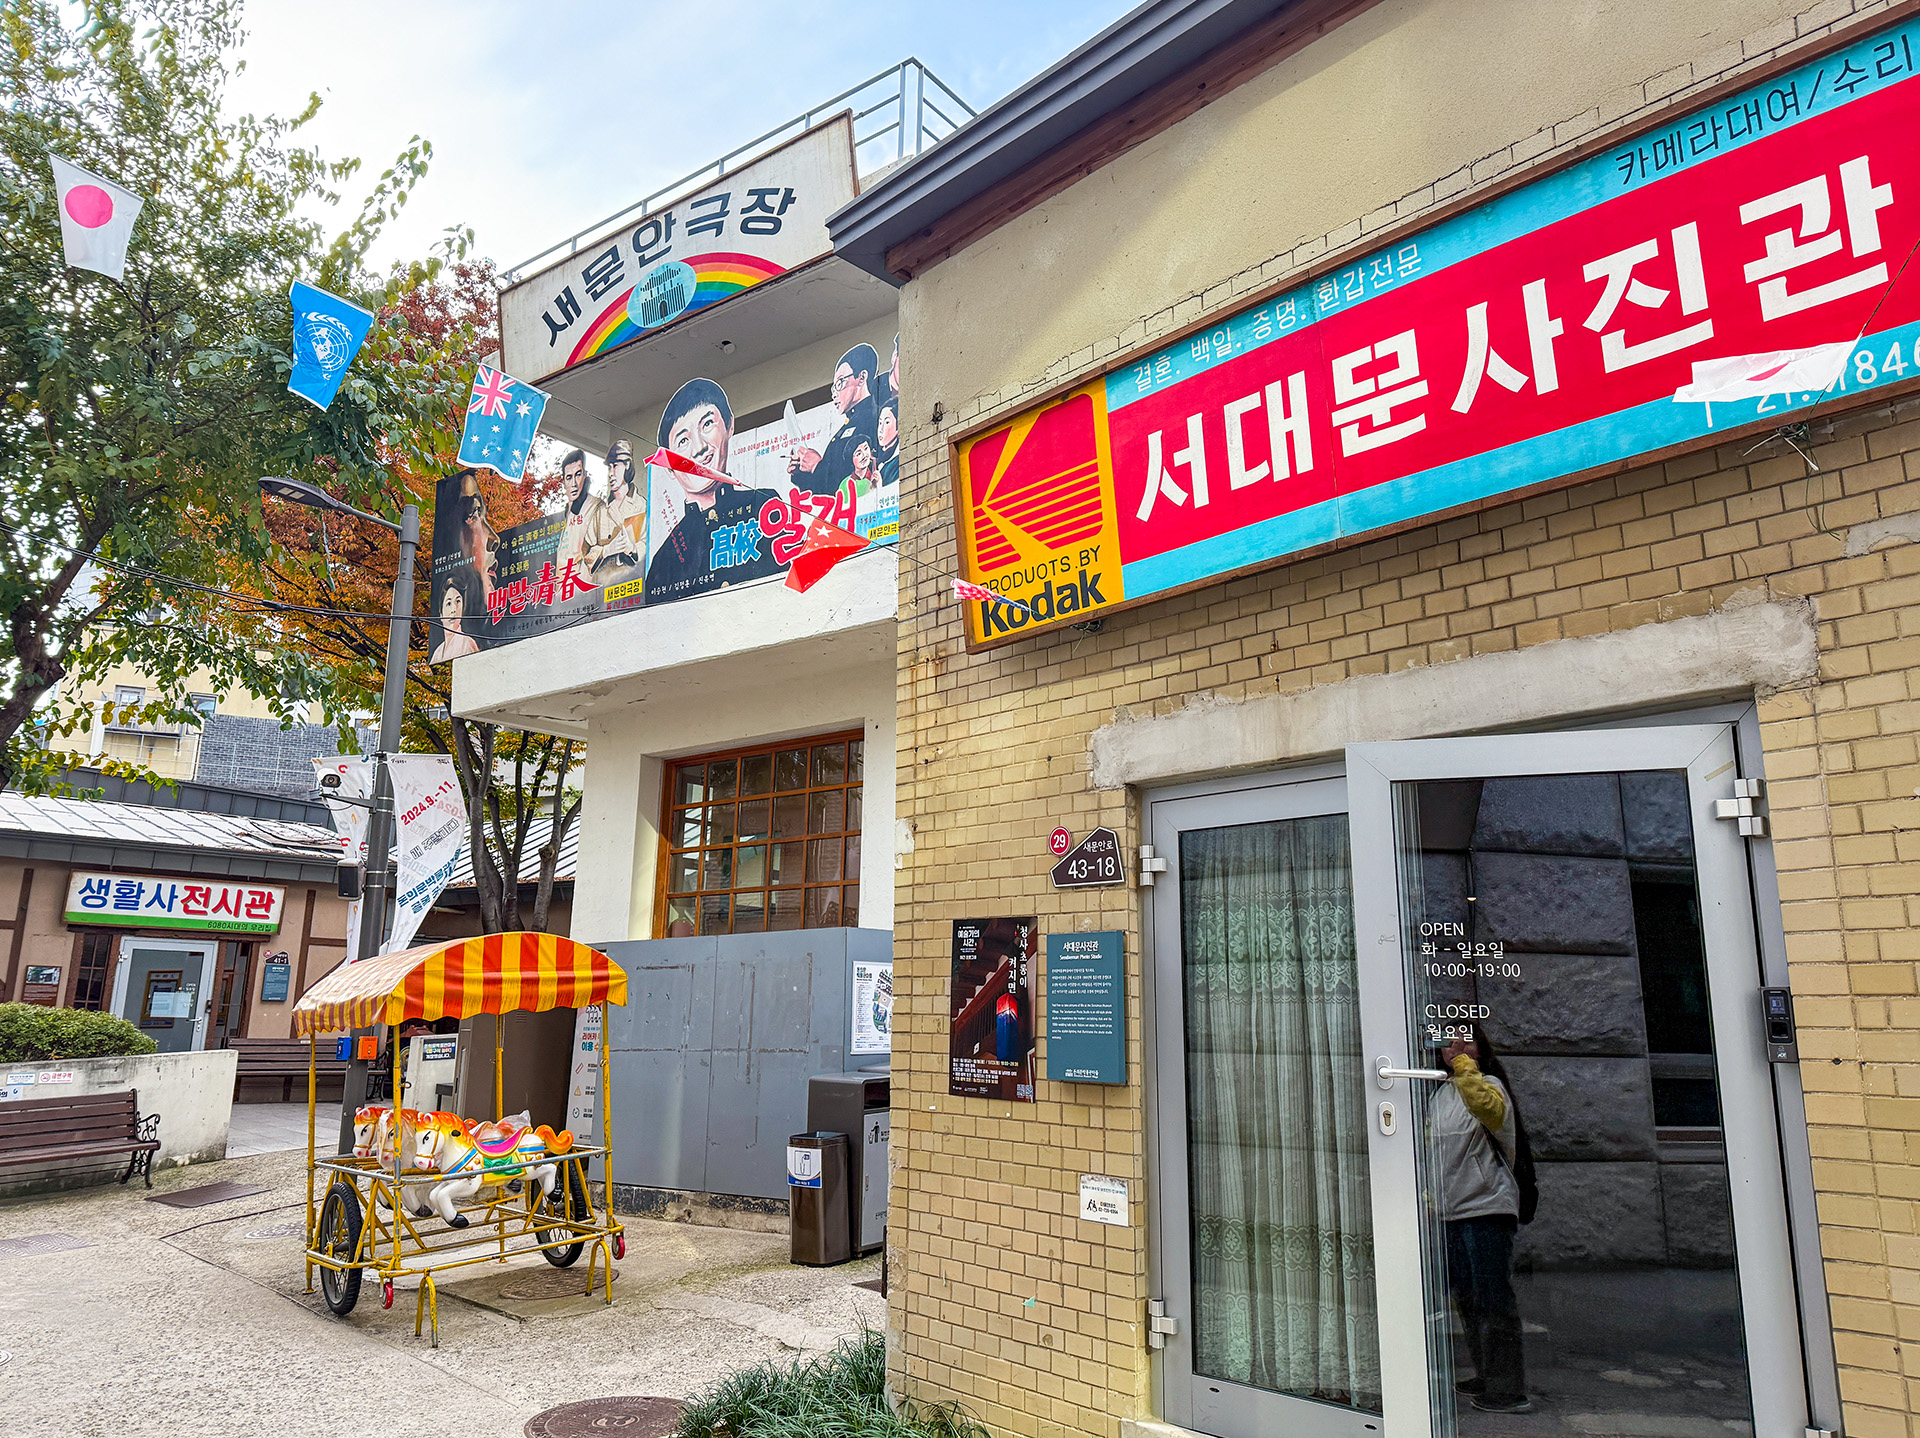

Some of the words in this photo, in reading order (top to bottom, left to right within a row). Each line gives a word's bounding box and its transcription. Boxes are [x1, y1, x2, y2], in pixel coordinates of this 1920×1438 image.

[541, 187, 797, 348] 새문안극장
[1133, 355, 1180, 393] 결혼.
[1190, 328, 1242, 363] 백일.
[1252, 296, 1307, 341] 증명.
[1317, 243, 1422, 311] 환갑전문
[1135, 155, 1894, 523] 서대문사진관
[869, 523, 898, 540] 새문안극
[607, 582, 640, 601] 새문안극장
[981, 569, 1106, 637] Kodak
[401, 781, 456, 826] 2024.9.-11.
[1053, 834, 1066, 849] 29
[1083, 840, 1114, 853] 새문안로
[1068, 856, 1115, 879] 43-18
[1420, 922, 1465, 937] OPEN
[1062, 940, 1099, 952] 서대문사진관
[1421, 942, 1438, 958] 화
[1457, 941, 1504, 959] 일요일
[1423, 962, 1521, 978] 10:00~19:00
[1425, 1004, 1491, 1020] CLOSED
[1426, 1023, 1475, 1043] 월요일
